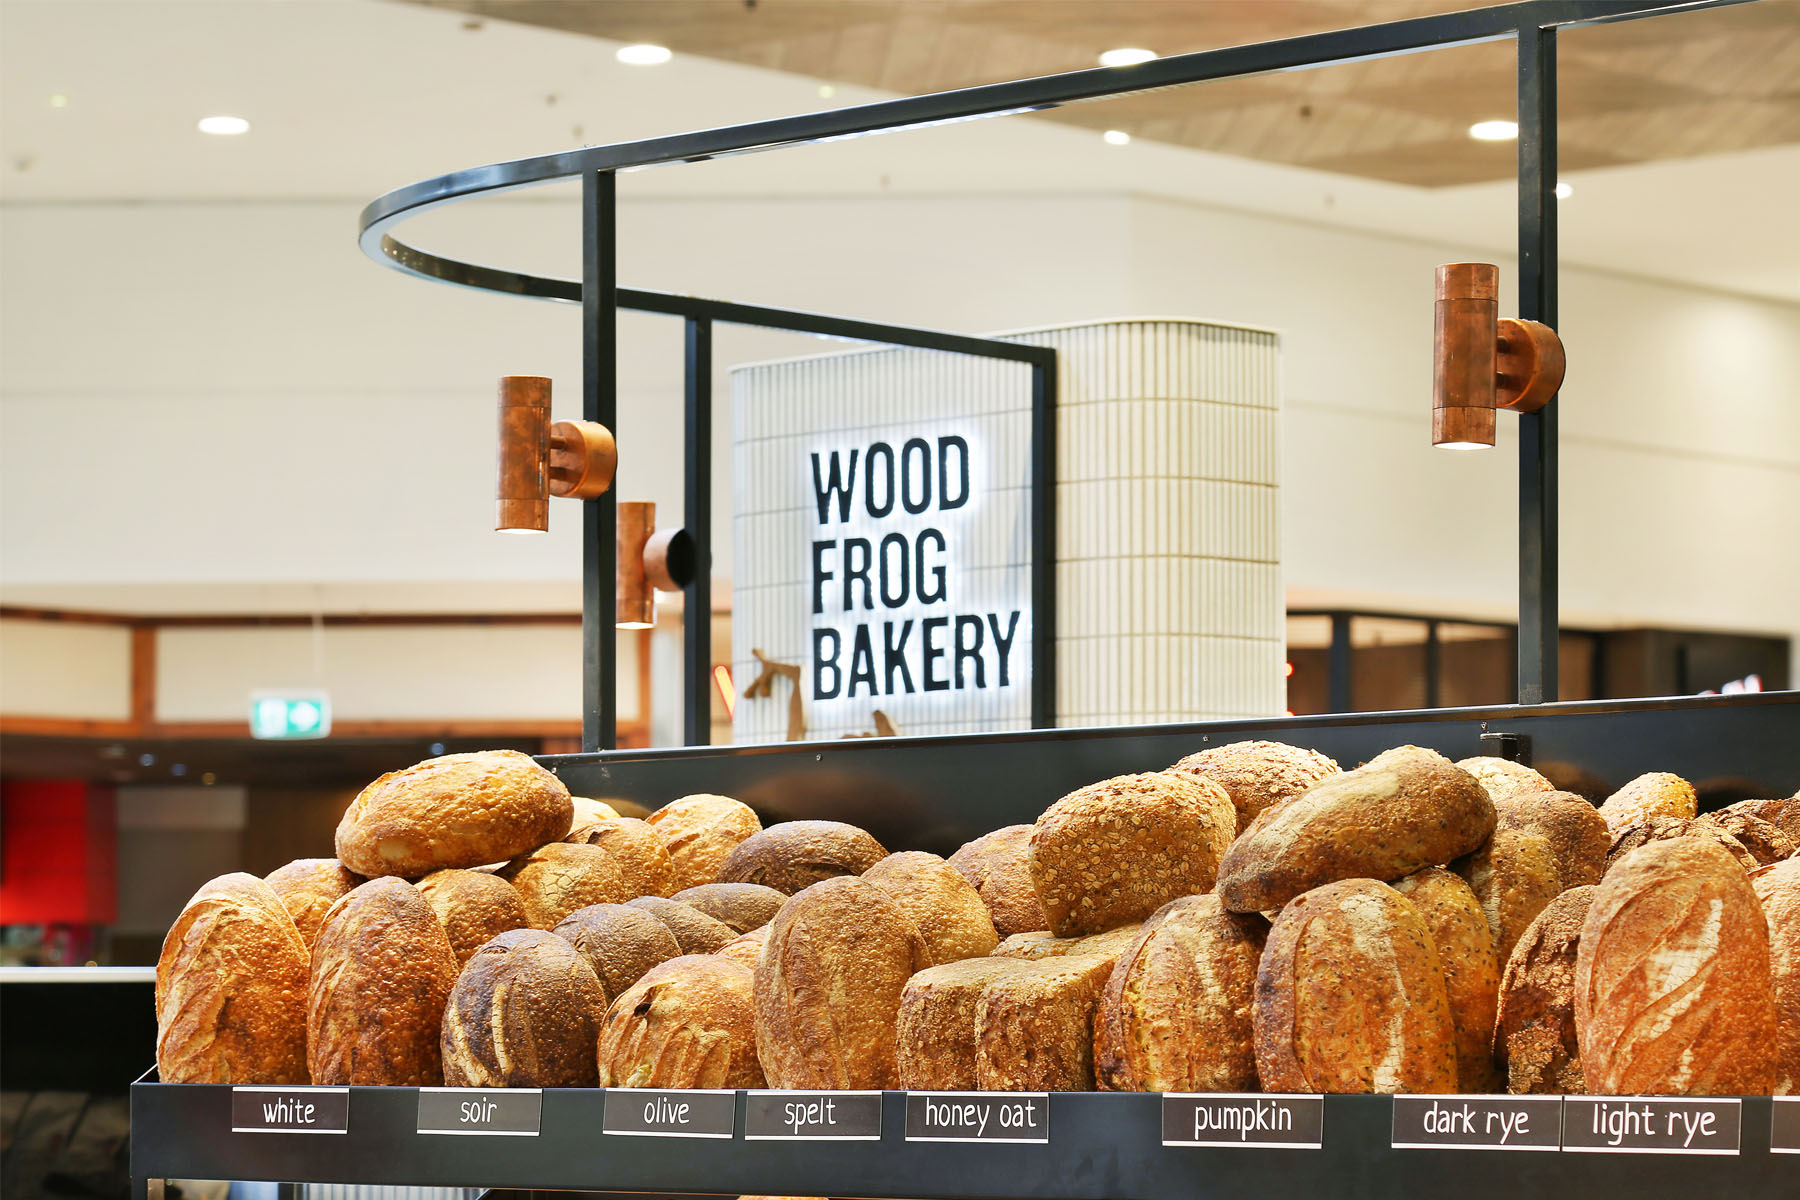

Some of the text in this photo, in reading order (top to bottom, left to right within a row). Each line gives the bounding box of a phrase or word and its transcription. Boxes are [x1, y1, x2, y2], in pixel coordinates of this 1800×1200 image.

[811, 435, 970, 524] WOOD
[812, 527, 947, 613] FROG
[813, 610, 1020, 700] BAKERY
[263, 1097, 316, 1124] white
[459, 1097, 498, 1124] soir
[643, 1097, 690, 1124] olive
[784, 1098, 837, 1135] spelt
[925, 1097, 1037, 1137] honey oat
[1194, 1099, 1292, 1142] pumpkin
[1423, 1101, 1530, 1145] dark rye
[1592, 1103, 1717, 1148] light rye
